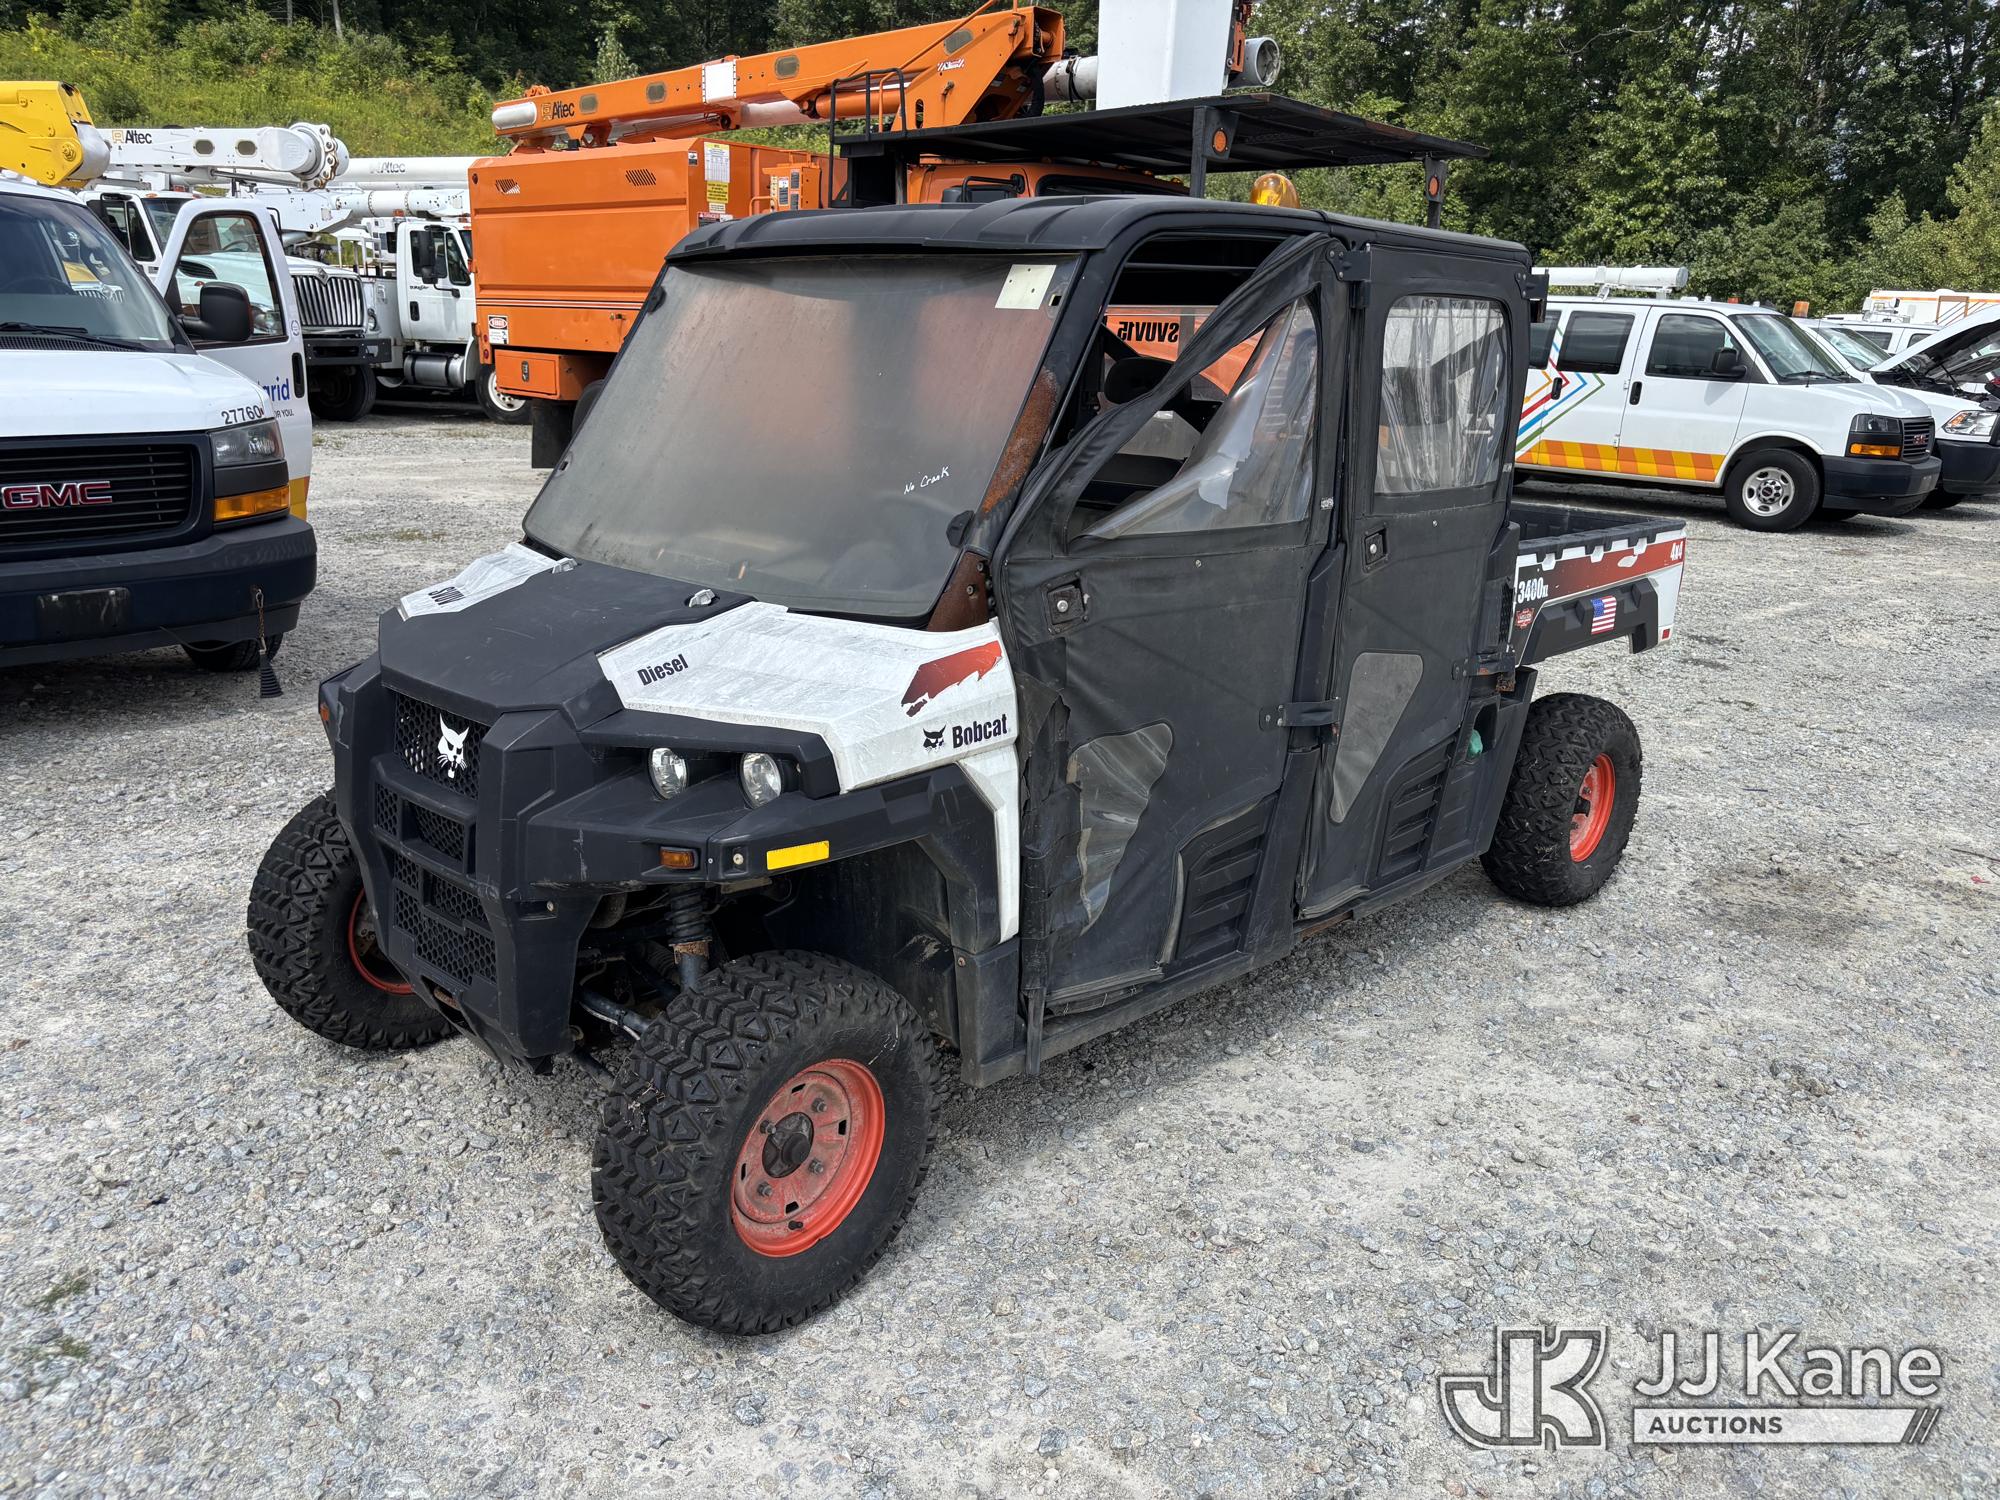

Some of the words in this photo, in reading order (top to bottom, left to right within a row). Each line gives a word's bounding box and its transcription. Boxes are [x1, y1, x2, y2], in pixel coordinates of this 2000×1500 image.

[551, 100, 575, 119] Altec
[125, 130, 153, 144] Altec
[380, 161, 406, 173] Altec
[221, 405, 262, 425] 27760
[1, 480, 113, 509] GMC
[637, 653, 689, 686] Diesel
[952, 713, 1008, 749] Bobcat
